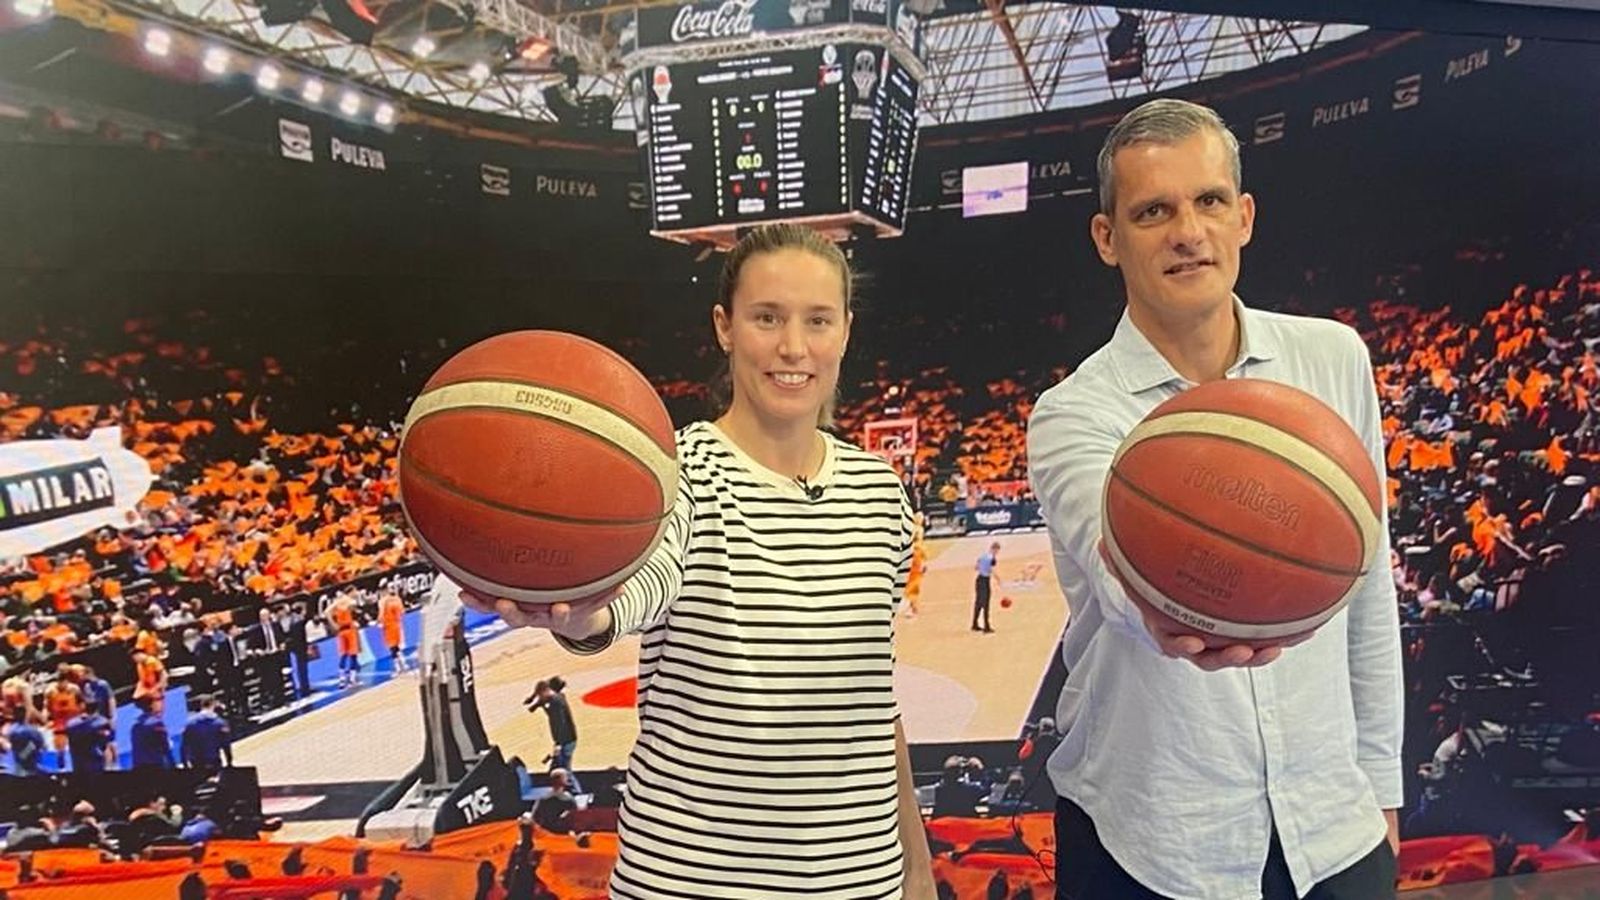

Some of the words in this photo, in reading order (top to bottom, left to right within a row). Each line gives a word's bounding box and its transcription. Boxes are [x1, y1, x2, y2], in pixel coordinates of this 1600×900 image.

[671, 0, 757, 42] Coca-Cola
[1312, 97, 1369, 127] PULEVA
[331, 137, 386, 170] PULEVA
[1031, 161, 1072, 179] LEVA
[536, 175, 598, 198] PULEVA
[5, 466, 112, 516] MILAR
[1180, 462, 1301, 531] molten
[456, 786, 494, 825] TKE
